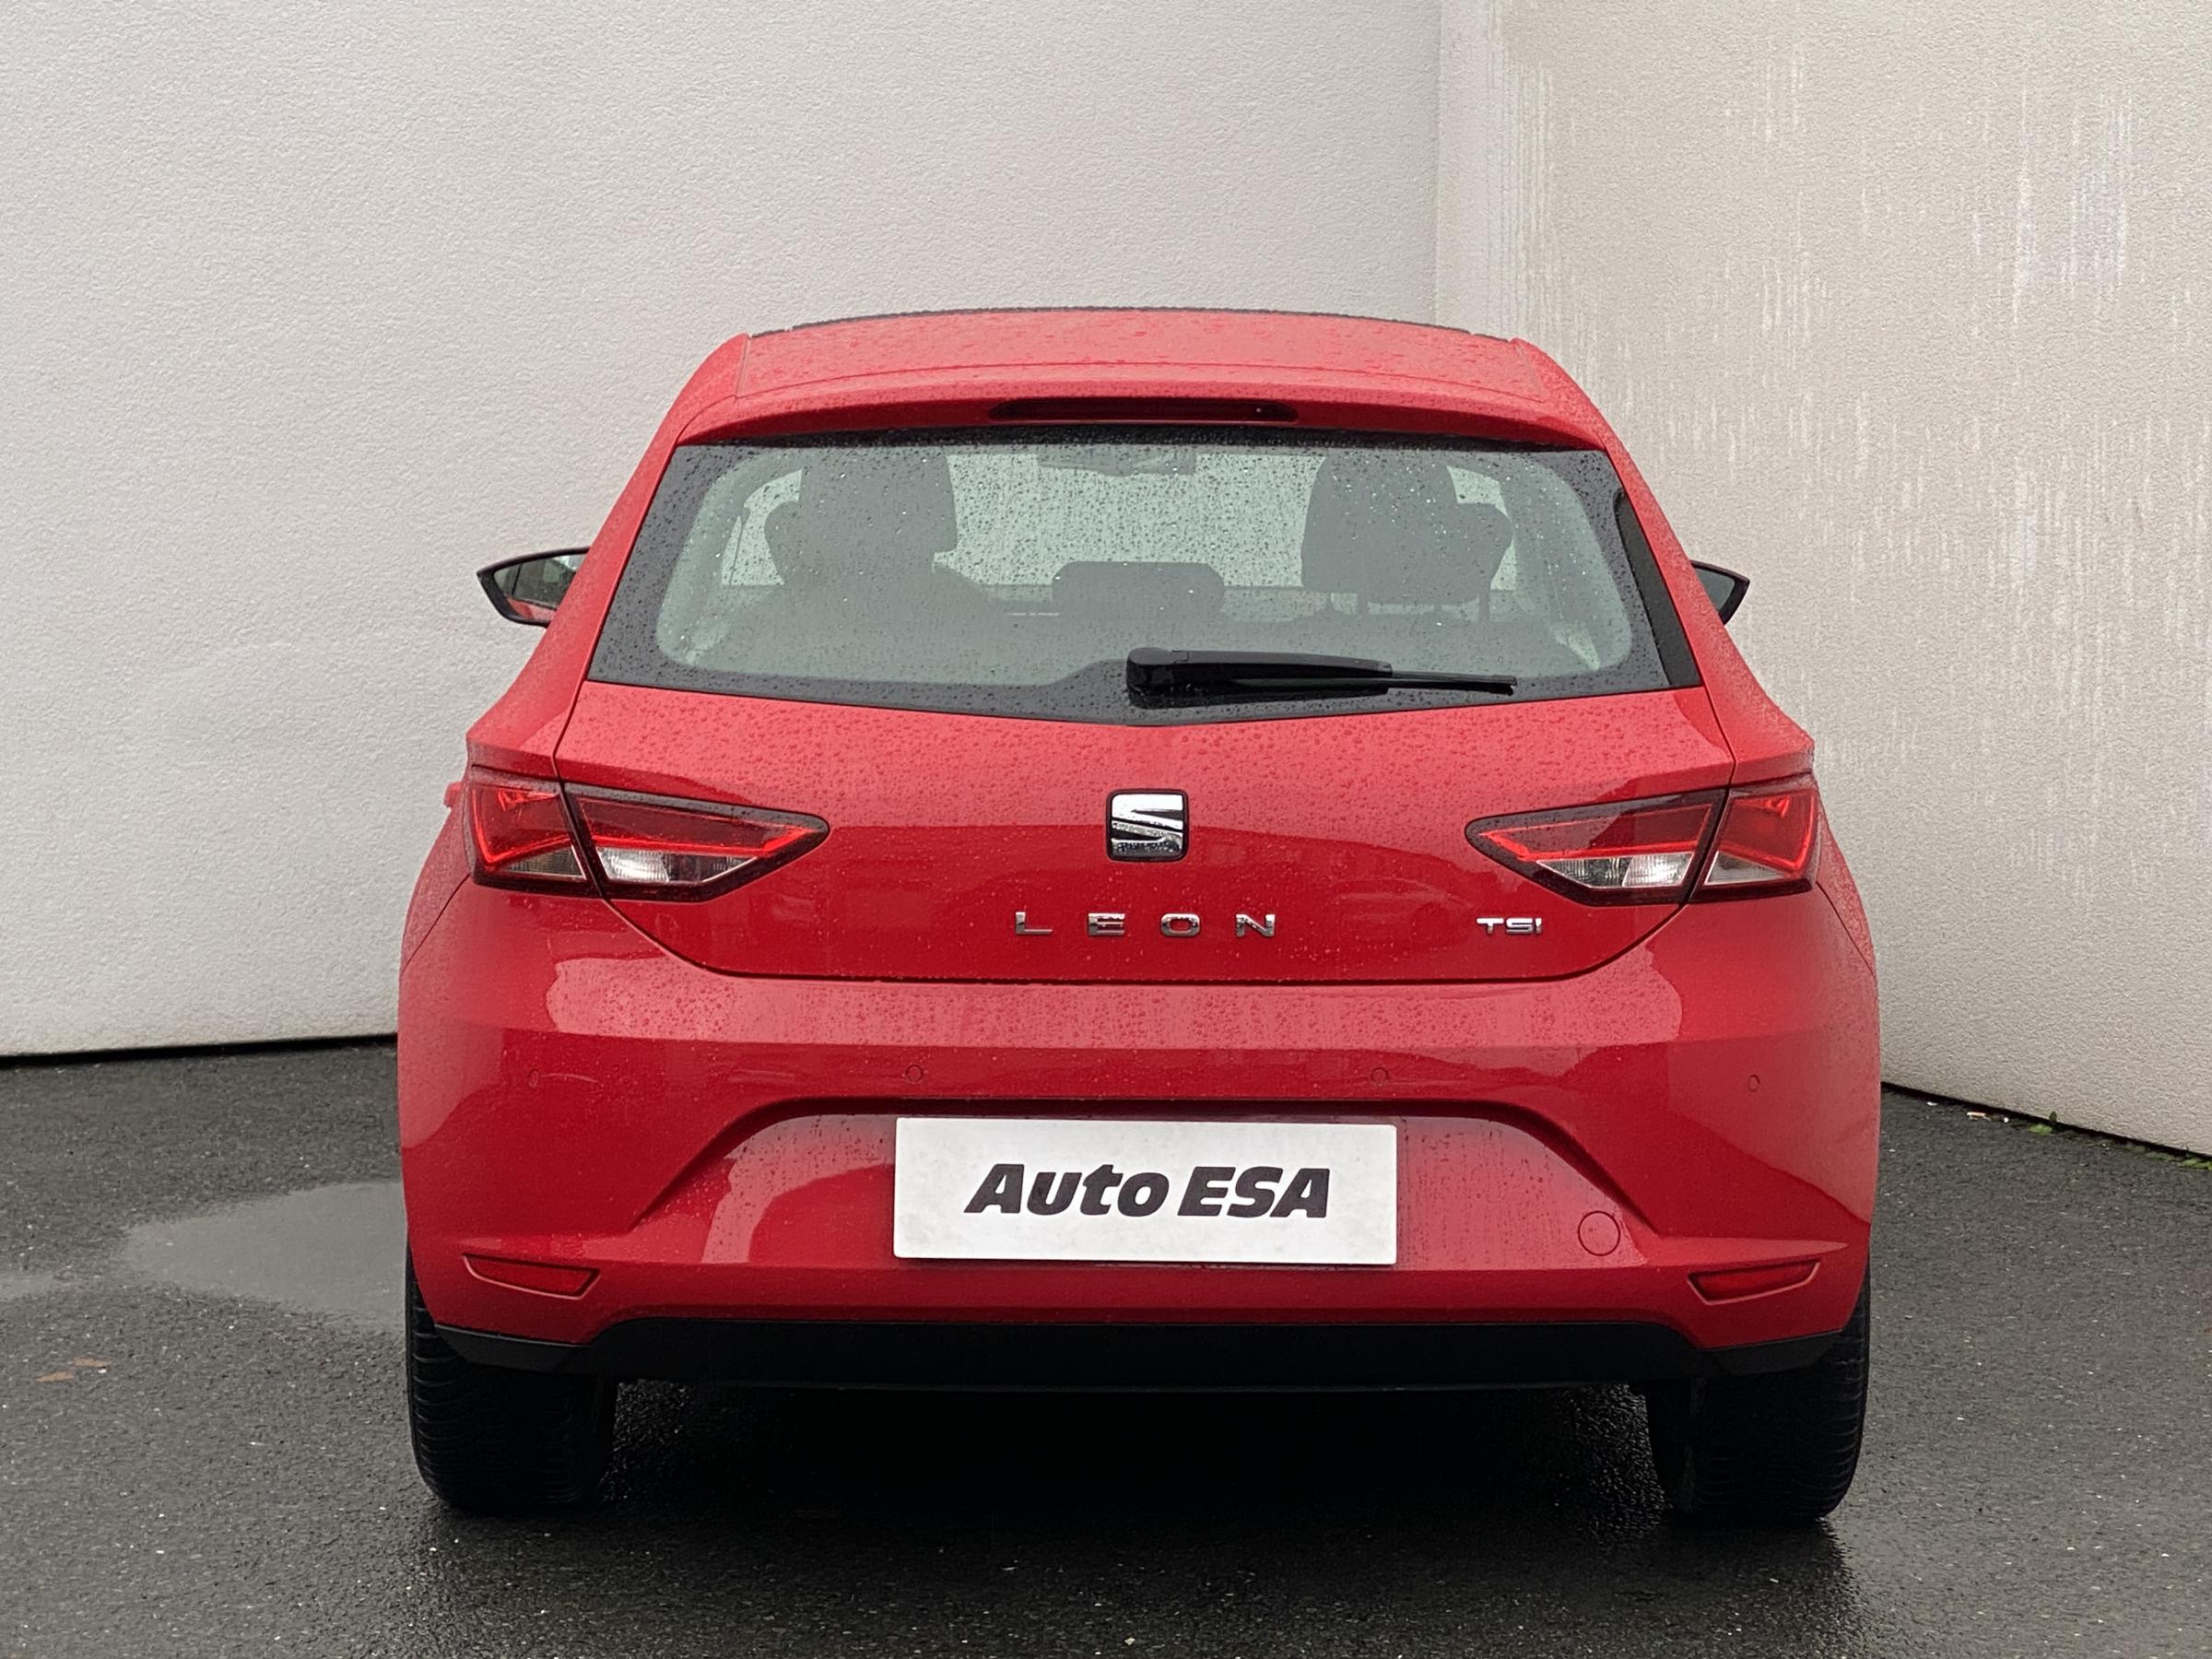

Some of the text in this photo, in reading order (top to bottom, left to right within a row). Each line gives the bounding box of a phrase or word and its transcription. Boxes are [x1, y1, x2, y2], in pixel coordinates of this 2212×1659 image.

[1015, 911, 1276, 937] LEON
[1477, 917, 1543, 935] TSI
[964, 1162, 1331, 1218] Auto ESA
